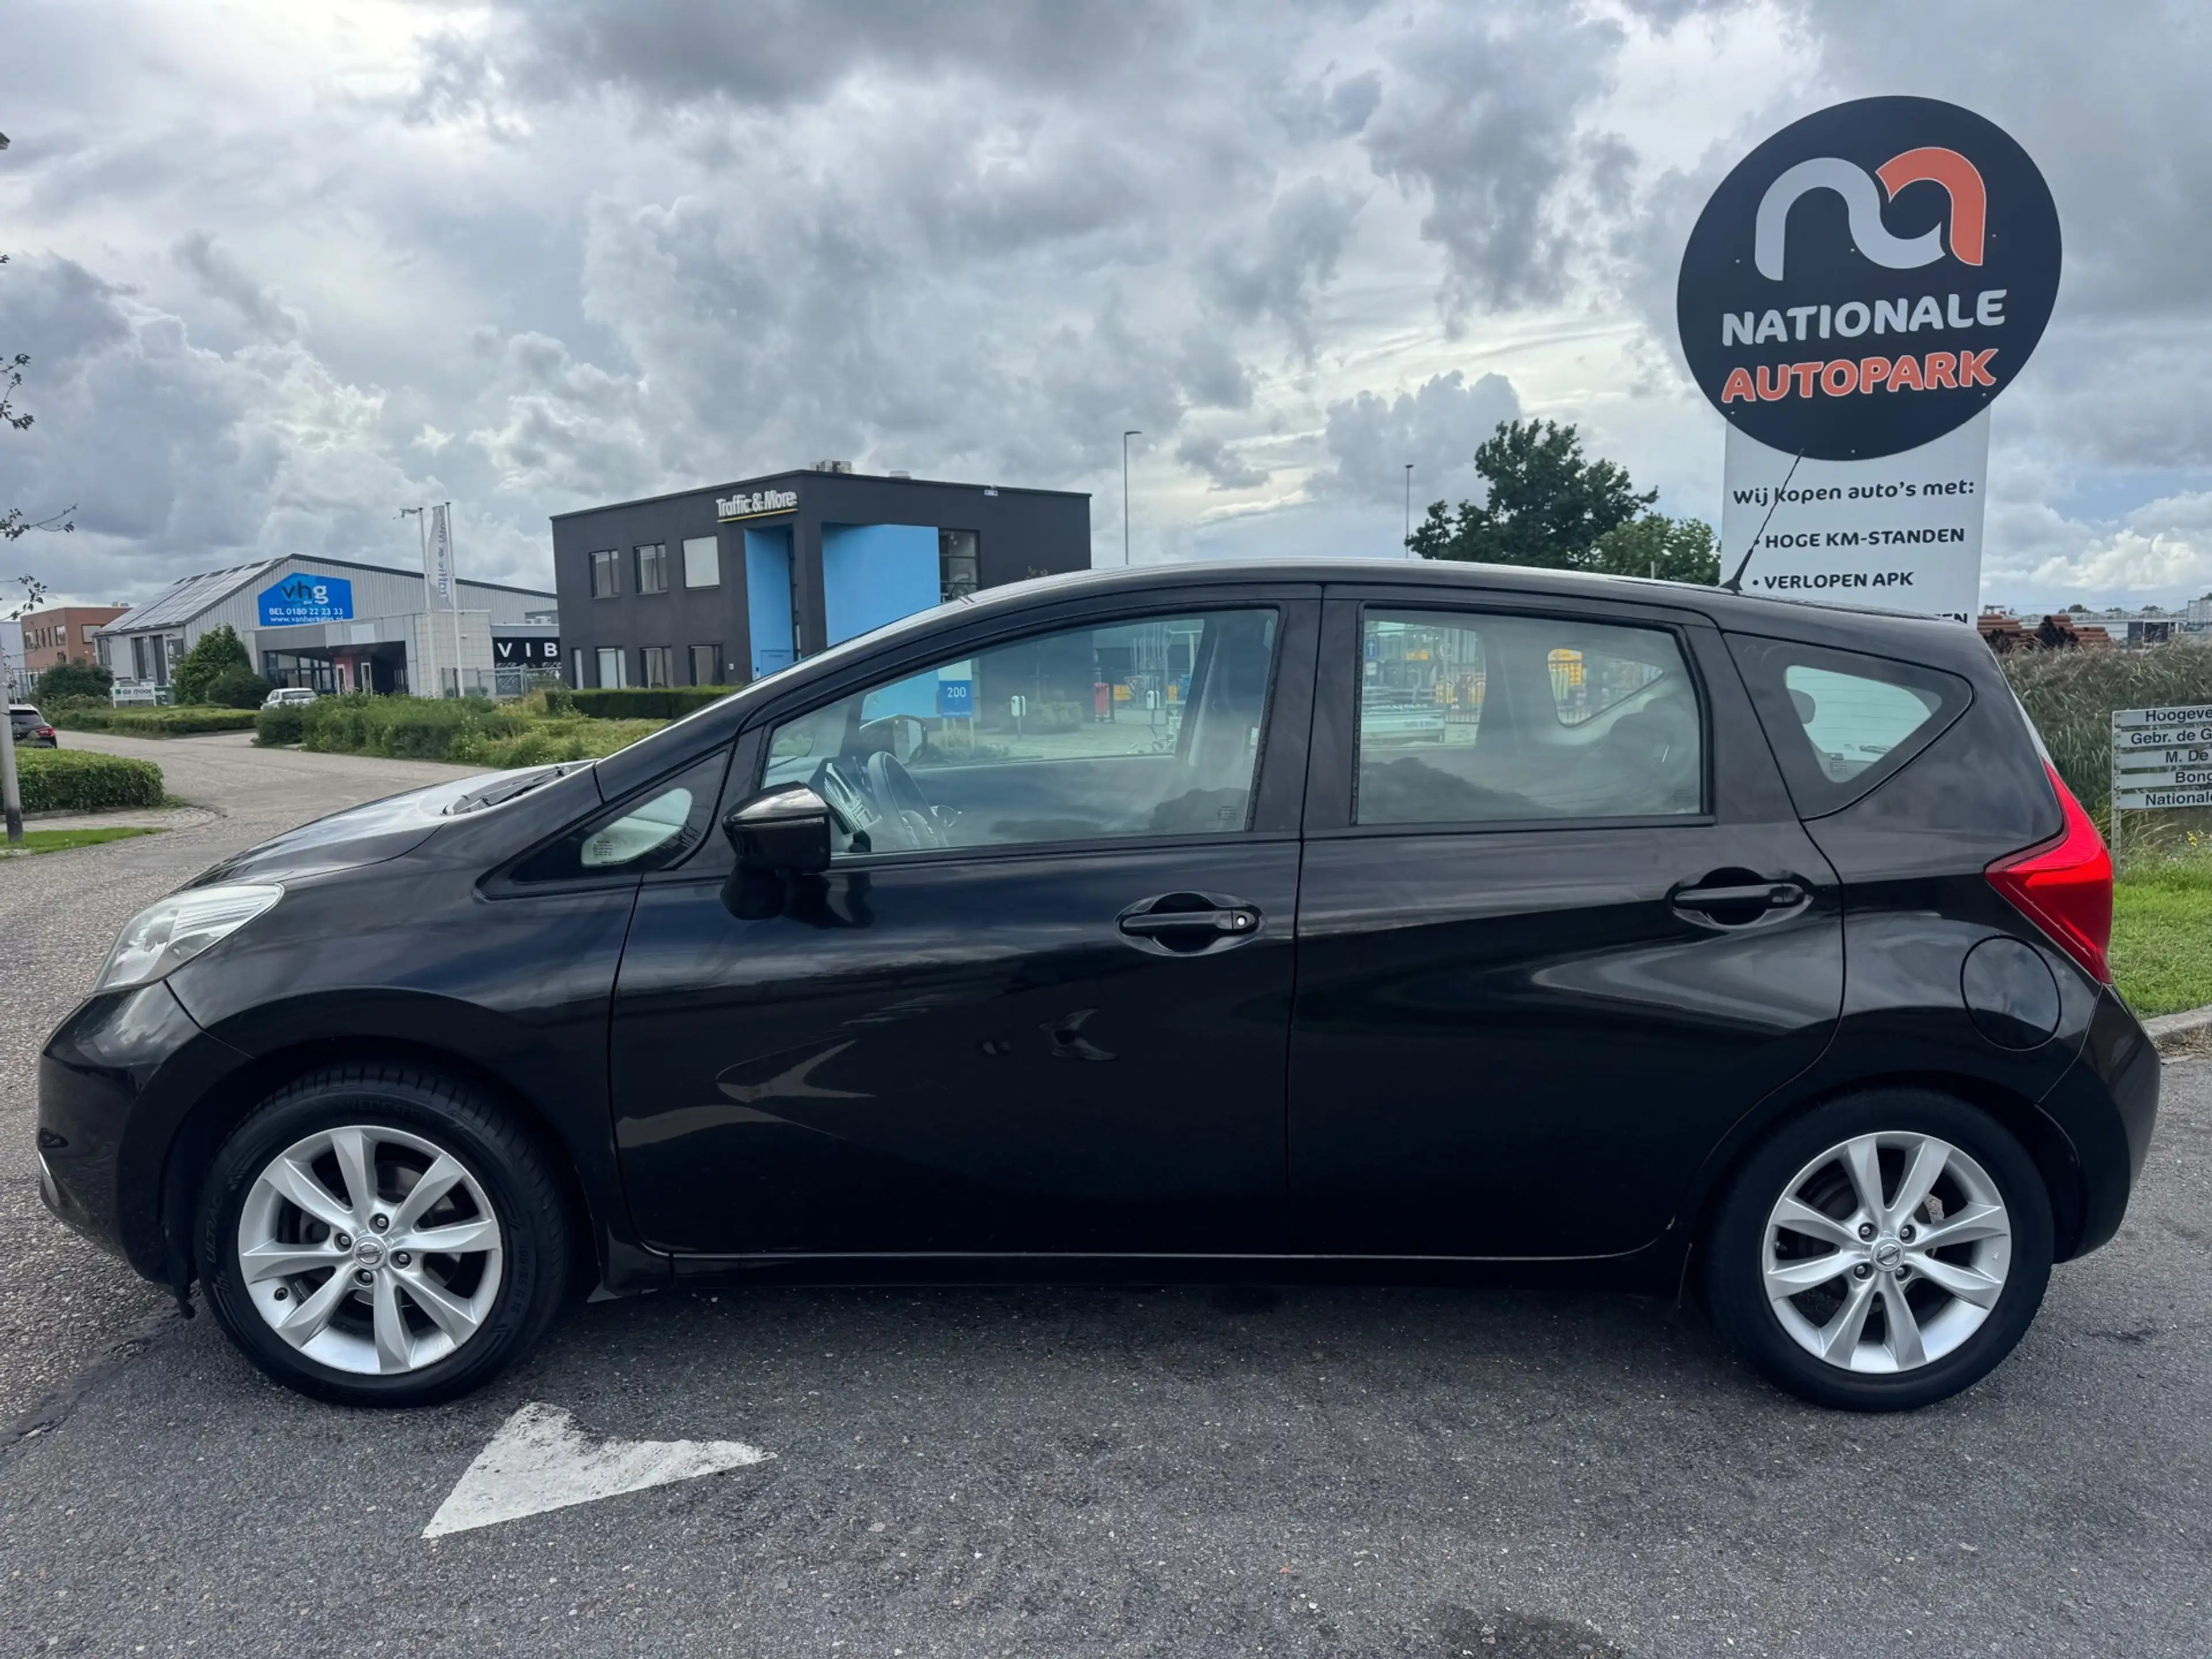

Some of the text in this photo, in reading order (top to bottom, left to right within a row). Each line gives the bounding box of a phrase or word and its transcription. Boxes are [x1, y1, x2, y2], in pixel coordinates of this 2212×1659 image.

[1722, 289, 2008, 346] NATIONALE
[1722, 349, 1999, 403] AUTOPARK
[1733, 487, 1768, 506] Wij
[1774, 487, 1841, 504] kopen
[1923, 479, 1974, 495] met:
[716, 490, 797, 517] Traffic & More
[1766, 528, 1964, 548] HOGE KM-STANDEN
[1764, 571, 1914, 589] VERLOPEN APK
[282, 580, 329, 604] vhg
[947, 686, 966, 698] 200
[2131, 732, 2171, 744] Gebr.
[2177, 729, 2196, 741] de
[2165, 751, 2208, 763] M. De
[2145, 791, 2212, 806] National
